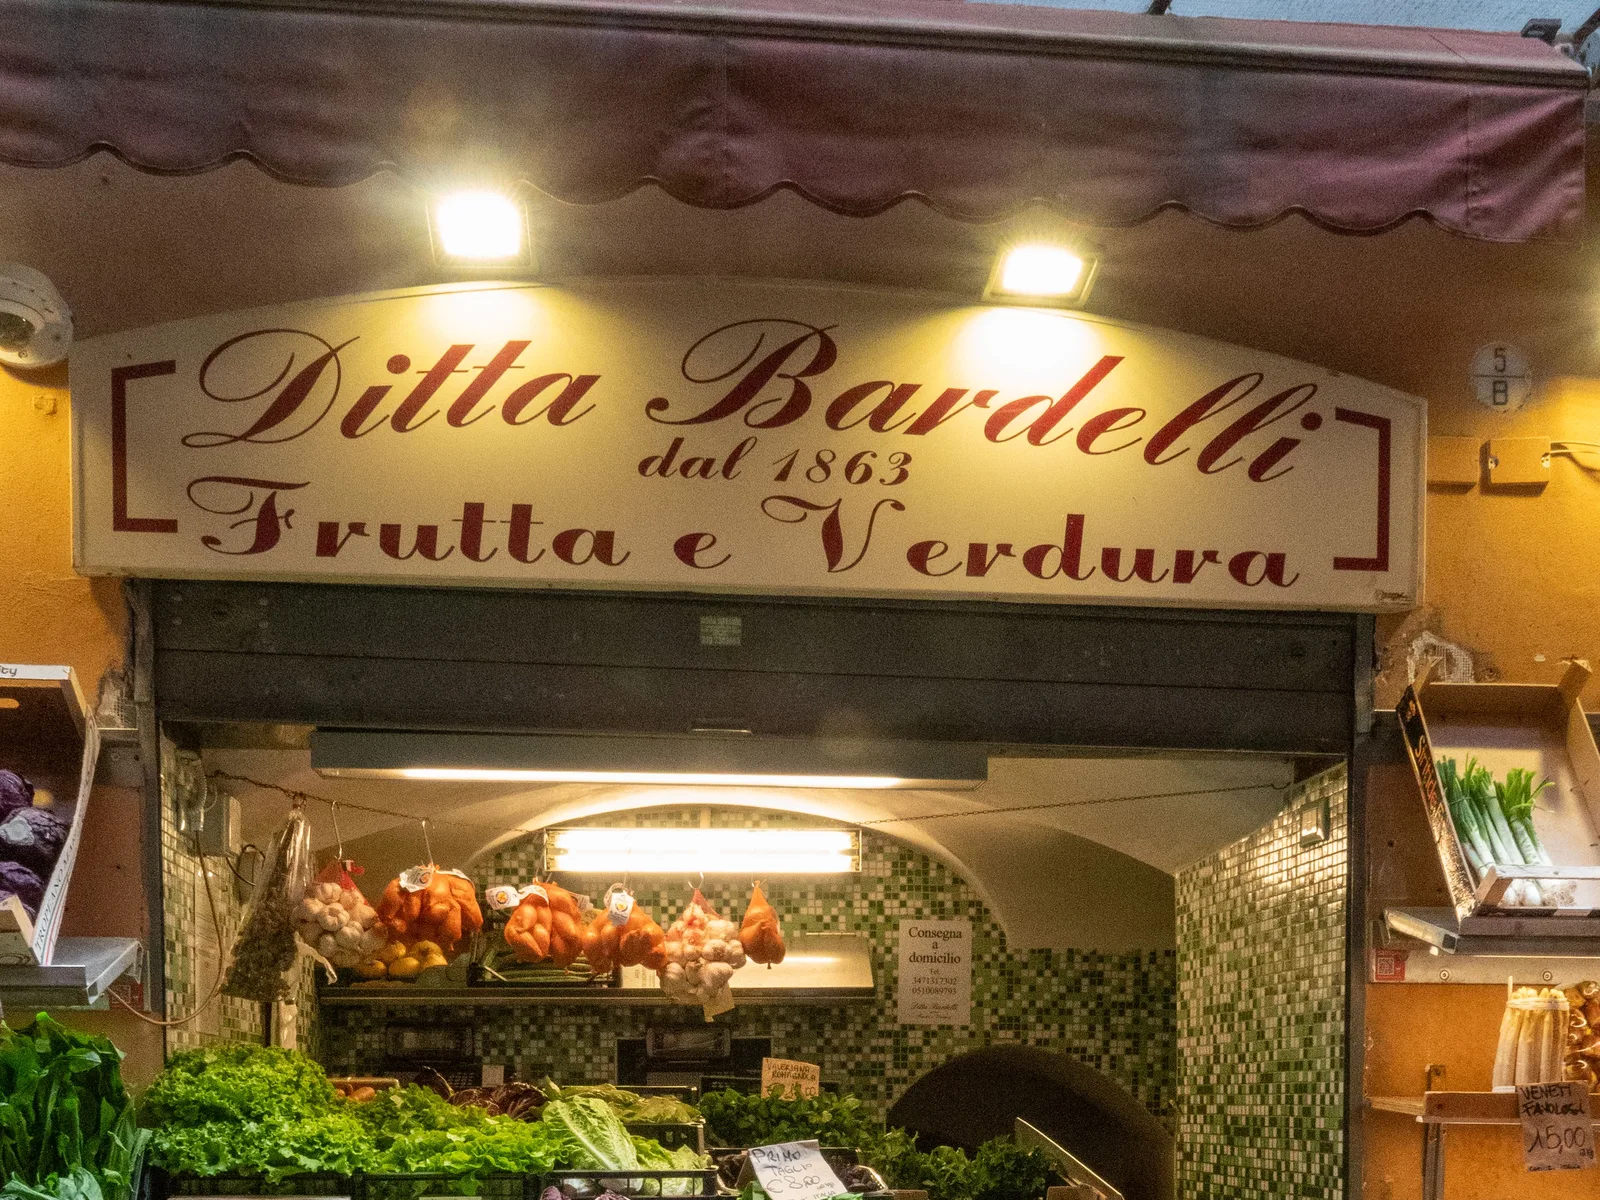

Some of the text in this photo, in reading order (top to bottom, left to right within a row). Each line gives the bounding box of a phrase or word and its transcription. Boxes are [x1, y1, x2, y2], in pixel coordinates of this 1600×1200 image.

[1495, 348, 1506, 372] 5
[181, 318, 1319, 483] Ditta Bardelli
[637, 436, 912, 486] dal 1863
[187, 476, 1300, 588] Frutta e Verdura
[908, 926, 963, 941] Consegna
[931, 940, 939, 949] a
[908, 951, 961, 964] domicilio
[751, 1148, 801, 1163] PRIMO
